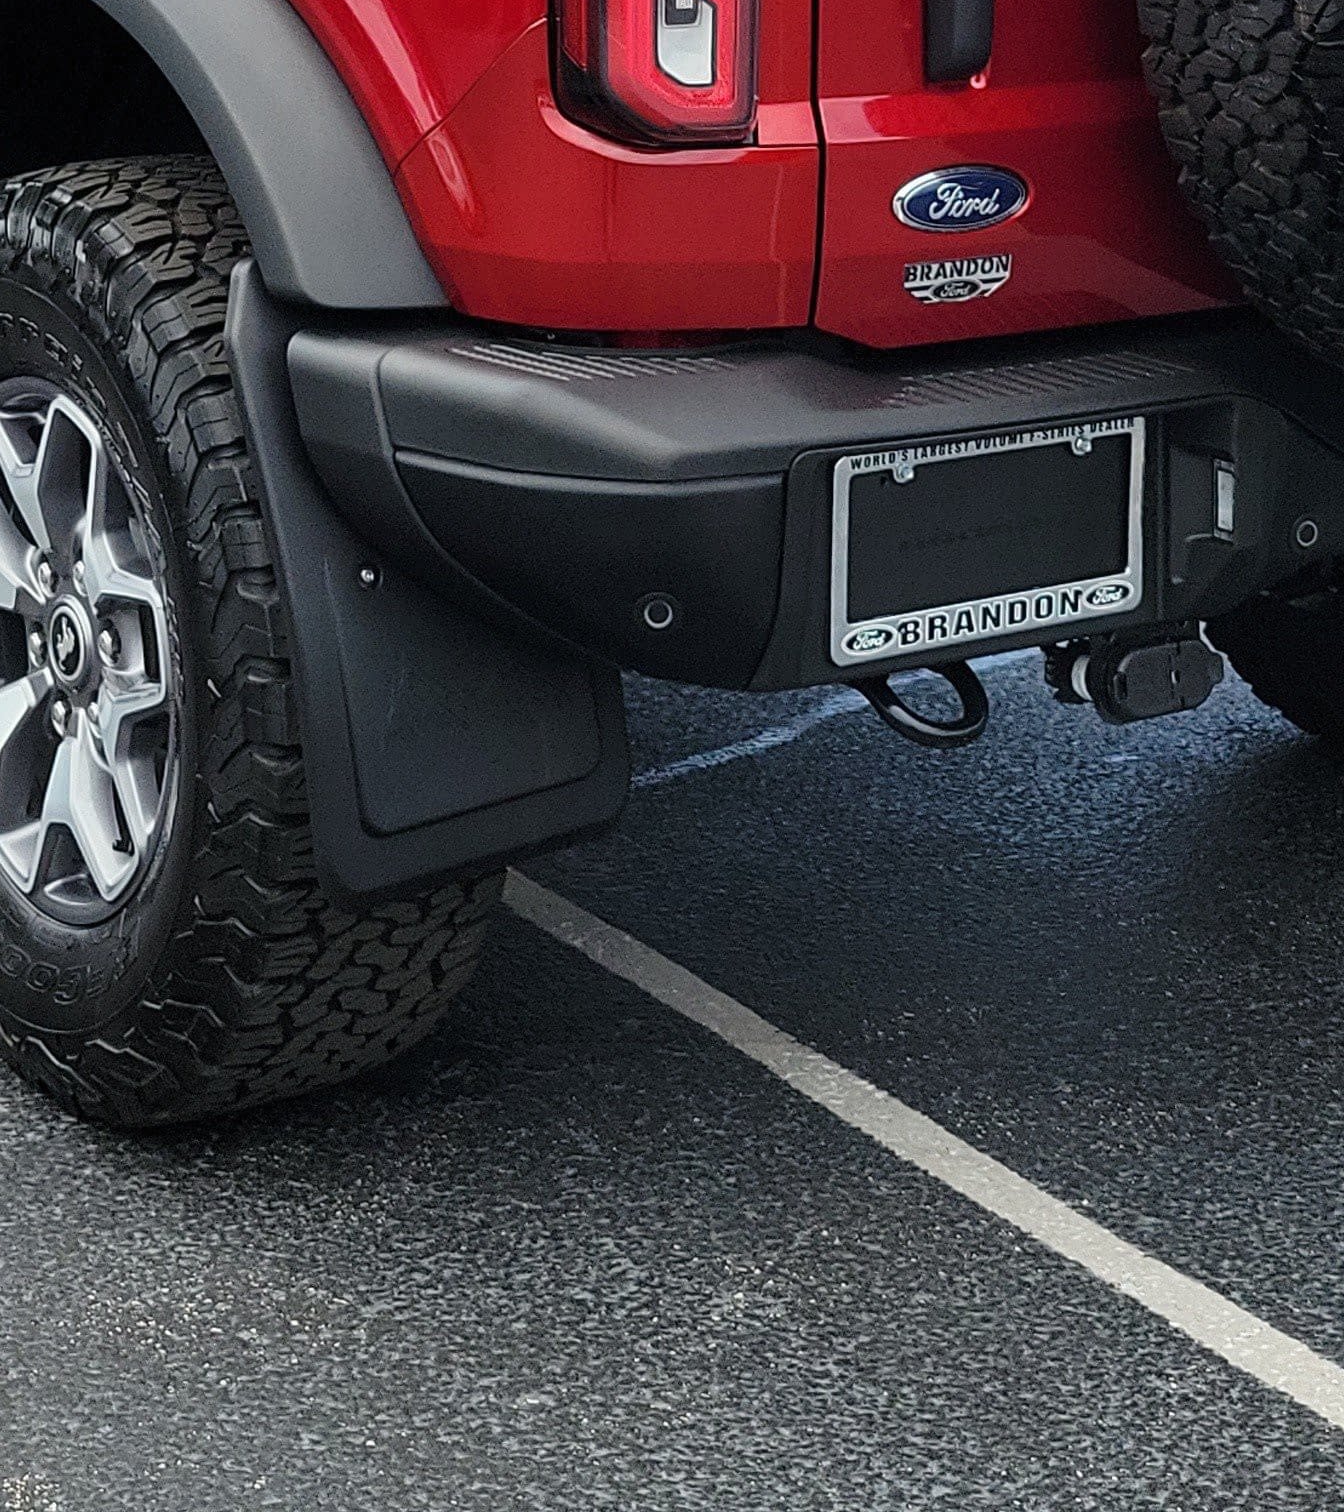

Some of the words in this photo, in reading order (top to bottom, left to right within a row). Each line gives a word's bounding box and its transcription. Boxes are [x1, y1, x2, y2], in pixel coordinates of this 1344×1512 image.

[928, 182, 1001, 221] Ford
[905, 254, 1010, 283] BRANDON
[939, 282, 971, 298] Ford
[850, 448, 910, 471] WORLD'S
[913, 439, 970, 461] LARGEST
[851, 629, 887, 651] Ford
[897, 589, 1084, 648] BRANDON
[1090, 583, 1126, 606] Ford
